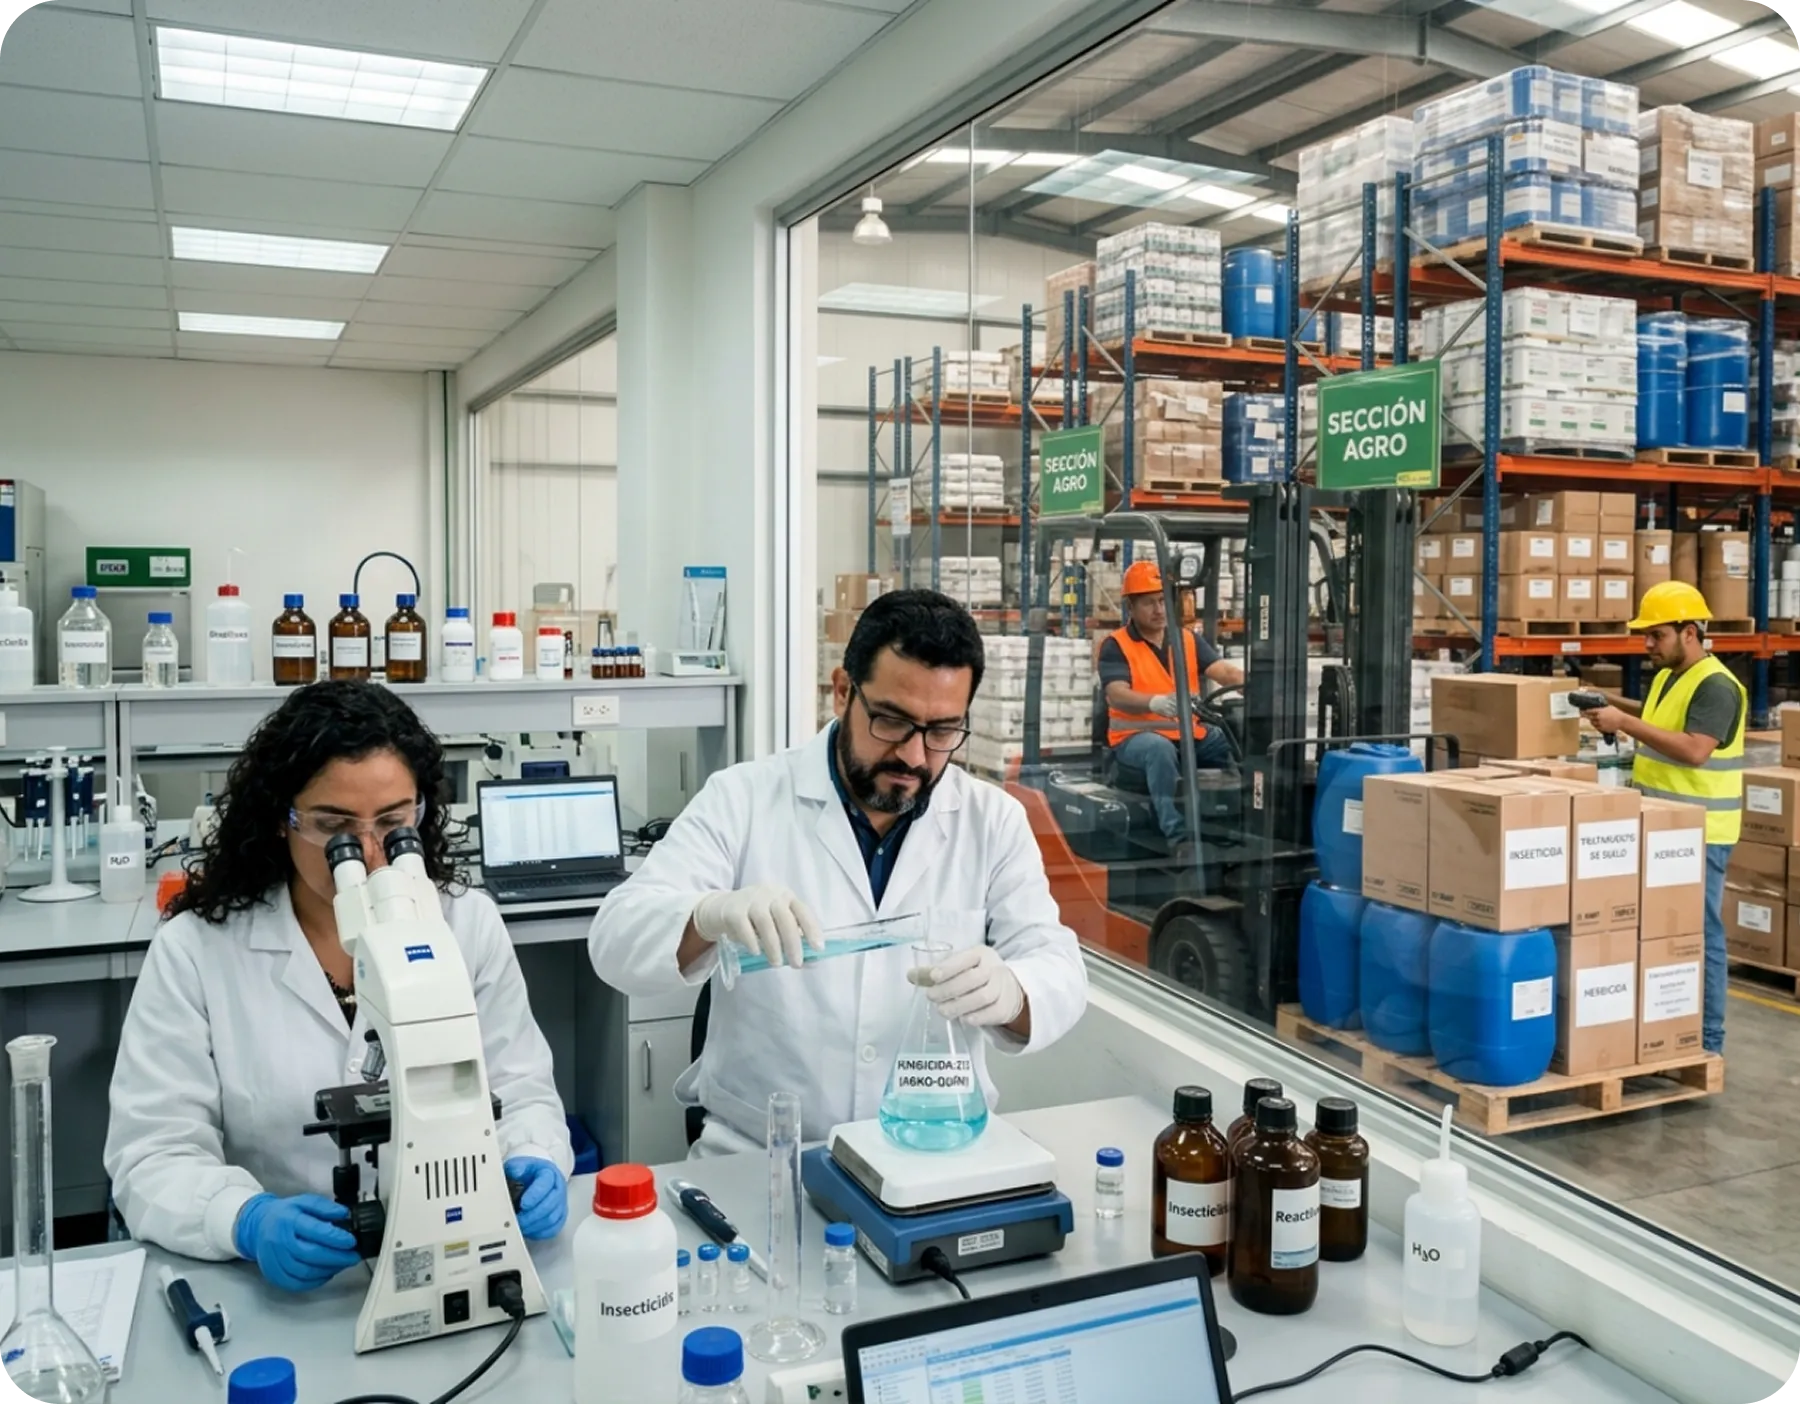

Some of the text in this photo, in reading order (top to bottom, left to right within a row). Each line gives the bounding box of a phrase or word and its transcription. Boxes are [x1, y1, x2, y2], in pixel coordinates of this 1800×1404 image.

[1327, 396, 1426, 435] SECCIÓN
[1343, 432, 1408, 461] AGRO
[1044, 448, 1097, 474] SECCIÓN
[1052, 474, 1088, 494] AGRO
